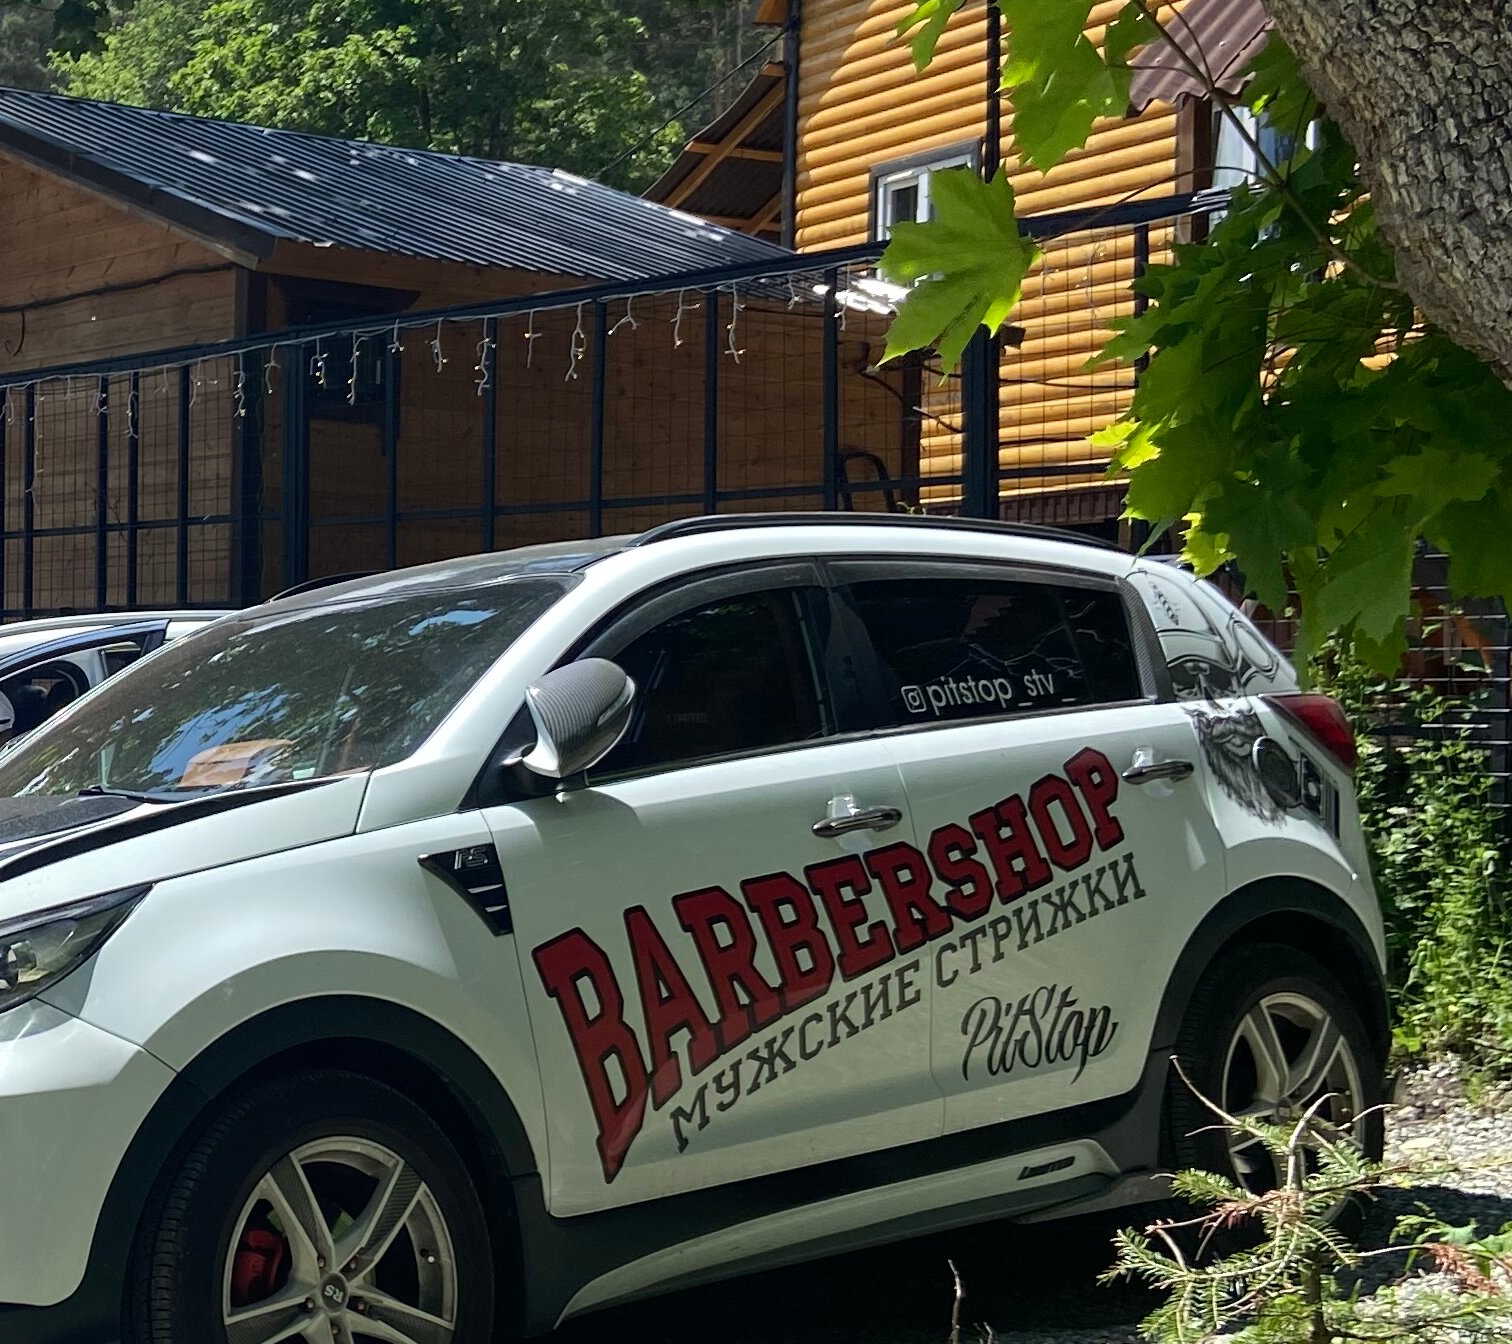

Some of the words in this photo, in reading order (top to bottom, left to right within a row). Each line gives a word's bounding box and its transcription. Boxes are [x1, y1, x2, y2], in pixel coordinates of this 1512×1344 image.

[531, 746, 1125, 1184] BARBERSHOP
[669, 959, 924, 1154] МУЖСКИЕ
[935, 852, 1147, 989] СТРИЖКИ
[960, 984, 1120, 1086] PitStop
